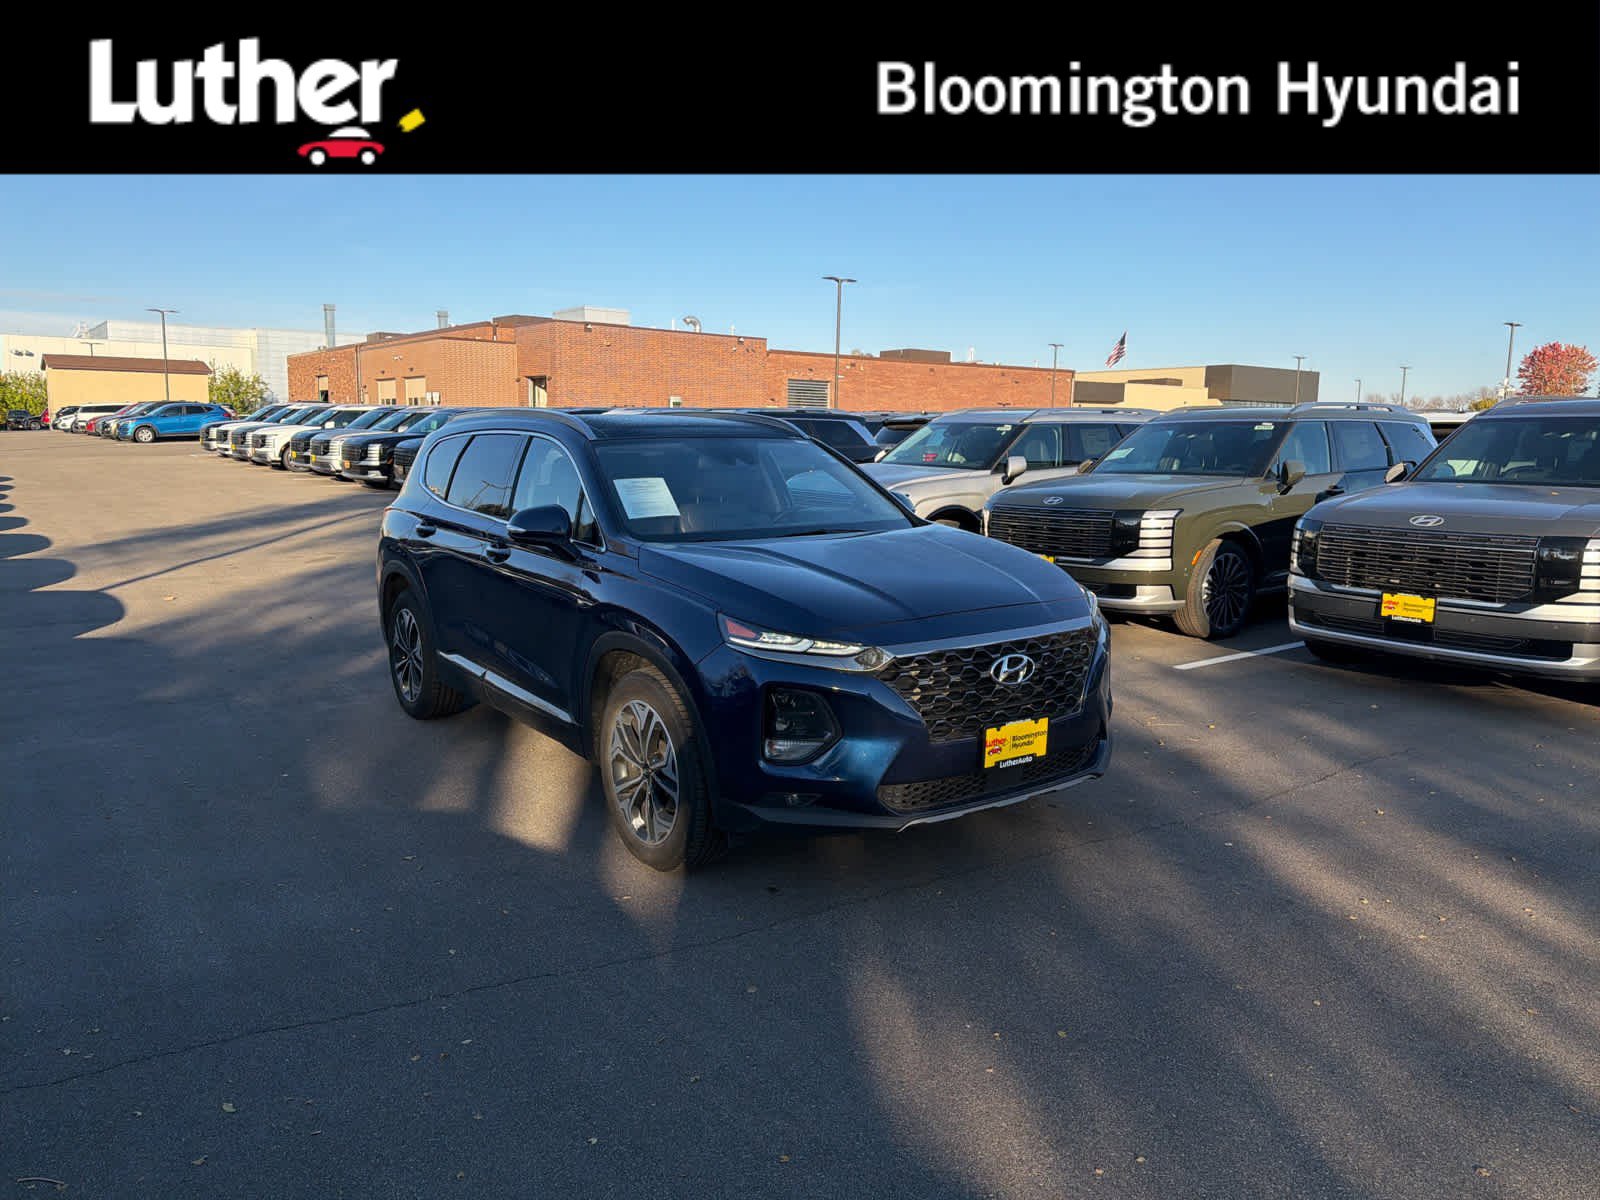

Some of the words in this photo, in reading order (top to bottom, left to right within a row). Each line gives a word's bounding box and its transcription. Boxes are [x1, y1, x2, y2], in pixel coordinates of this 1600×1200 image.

[1012, 730, 1048, 742] Bloomington
[986, 737, 1007, 748] Luther
[1012, 740, 1034, 750] Hyundai
[999, 755, 1033, 769] LutherAuto
